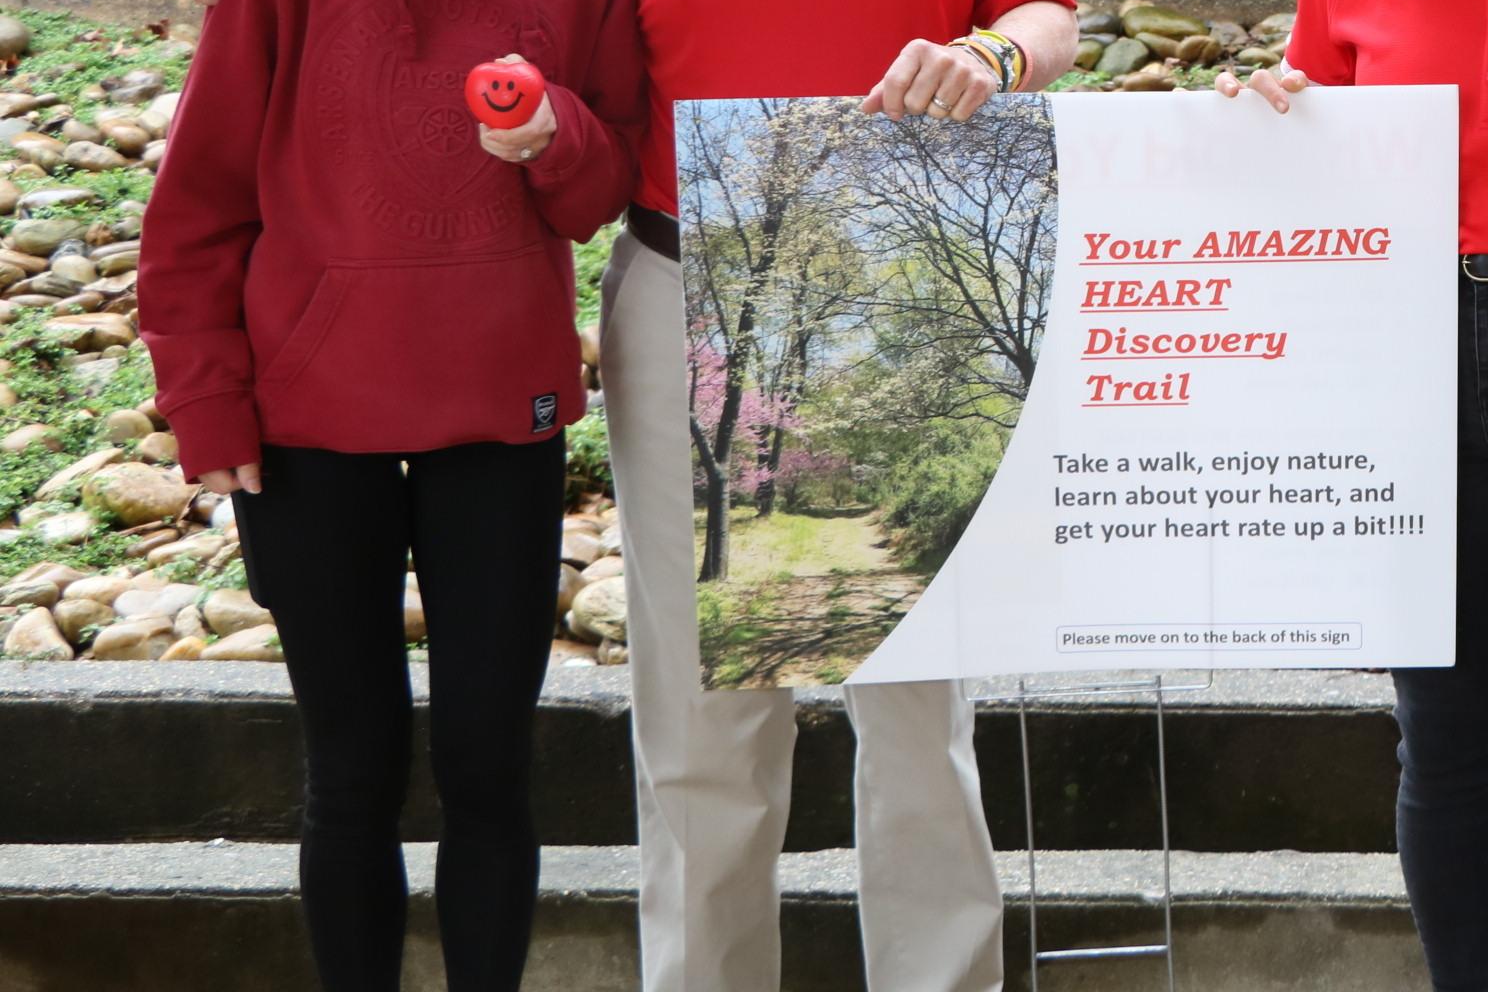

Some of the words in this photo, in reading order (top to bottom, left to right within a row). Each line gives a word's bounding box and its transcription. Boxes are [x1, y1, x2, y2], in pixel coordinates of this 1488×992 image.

[1085, 234, 1182, 260] Your
[1194, 228, 1391, 259] AMAZING
[1082, 279, 1231, 308] HEART
[1084, 328, 1287, 360] Discovery
[1087, 374, 1190, 402] Trail
[1052, 454, 1109, 474] Take
[1116, 458, 1130, 472] a
[1138, 452, 1203, 475] walk,
[1211, 451, 1280, 476] enjoy
[1287, 453, 1375, 473] nature,
[1054, 486, 1117, 507] learn
[1125, 485, 1198, 506] about
[1205, 489, 1261, 509] your
[1269, 483, 1341, 507] heart,
[1349, 481, 1395, 503] and
[1054, 522, 1094, 545] get
[1100, 523, 1157, 544] your
[1165, 517, 1230, 538] heart
[1238, 519, 1286, 537] rate
[1294, 521, 1325, 541] up
[1332, 521, 1346, 536] a
[1354, 514, 1424, 536] bit!!!!
[1062, 632, 1110, 645] Please
[1115, 634, 1156, 644] move
[1160, 634, 1179, 643] on
[1183, 632, 1199, 643] to
[1203, 630, 1227, 643] the
[1232, 630, 1266, 643] back
[1270, 630, 1286, 643] of
[1290, 630, 1317, 643] this
[1321, 631, 1350, 645] sign
